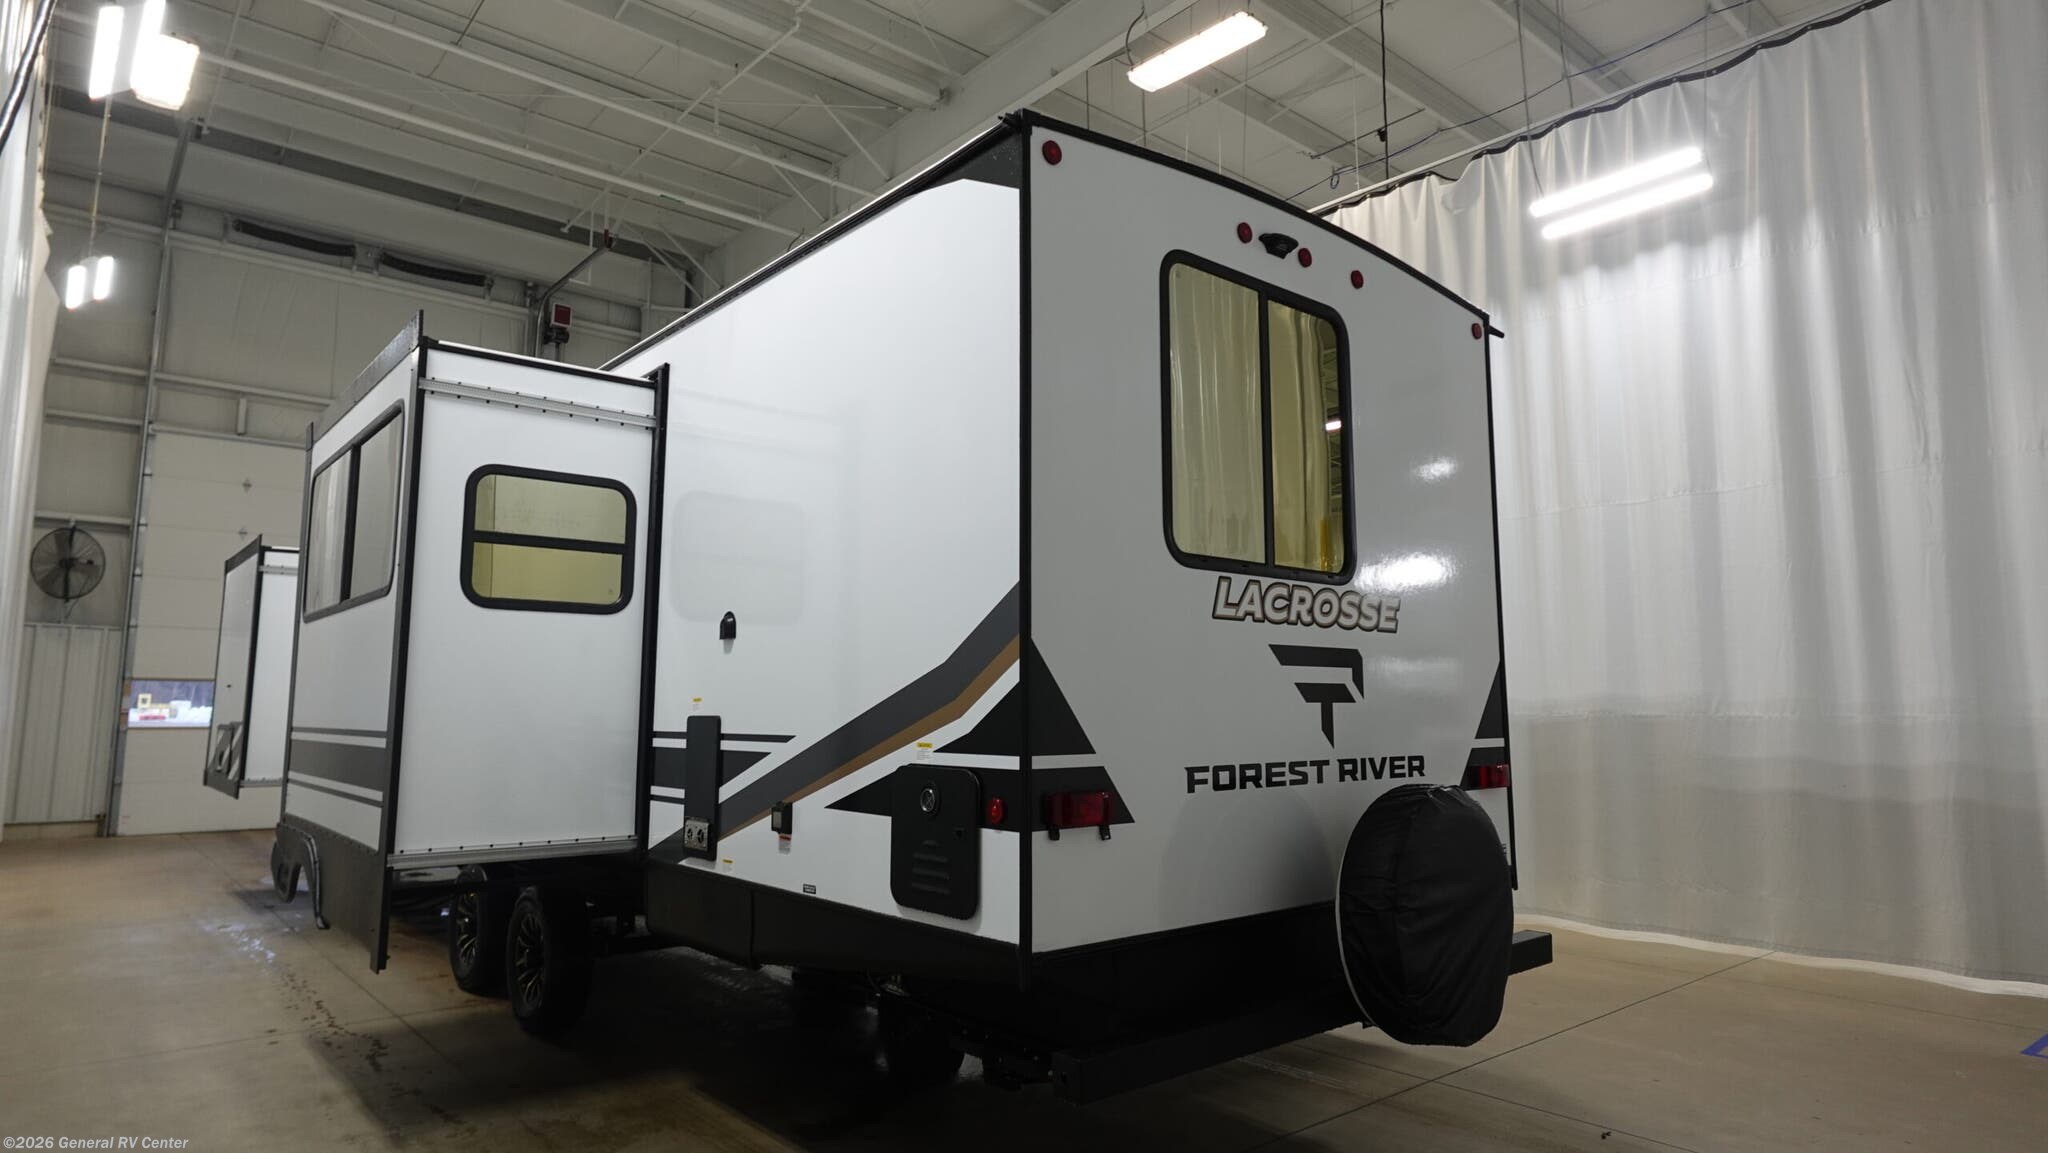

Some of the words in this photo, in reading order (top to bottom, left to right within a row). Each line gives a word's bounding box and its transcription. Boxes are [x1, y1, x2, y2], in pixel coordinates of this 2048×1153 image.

[1212, 576, 1401, 633] LACROSSE
[1184, 759, 1331, 794] FOREST
[1337, 755, 1426, 783] RIVER
